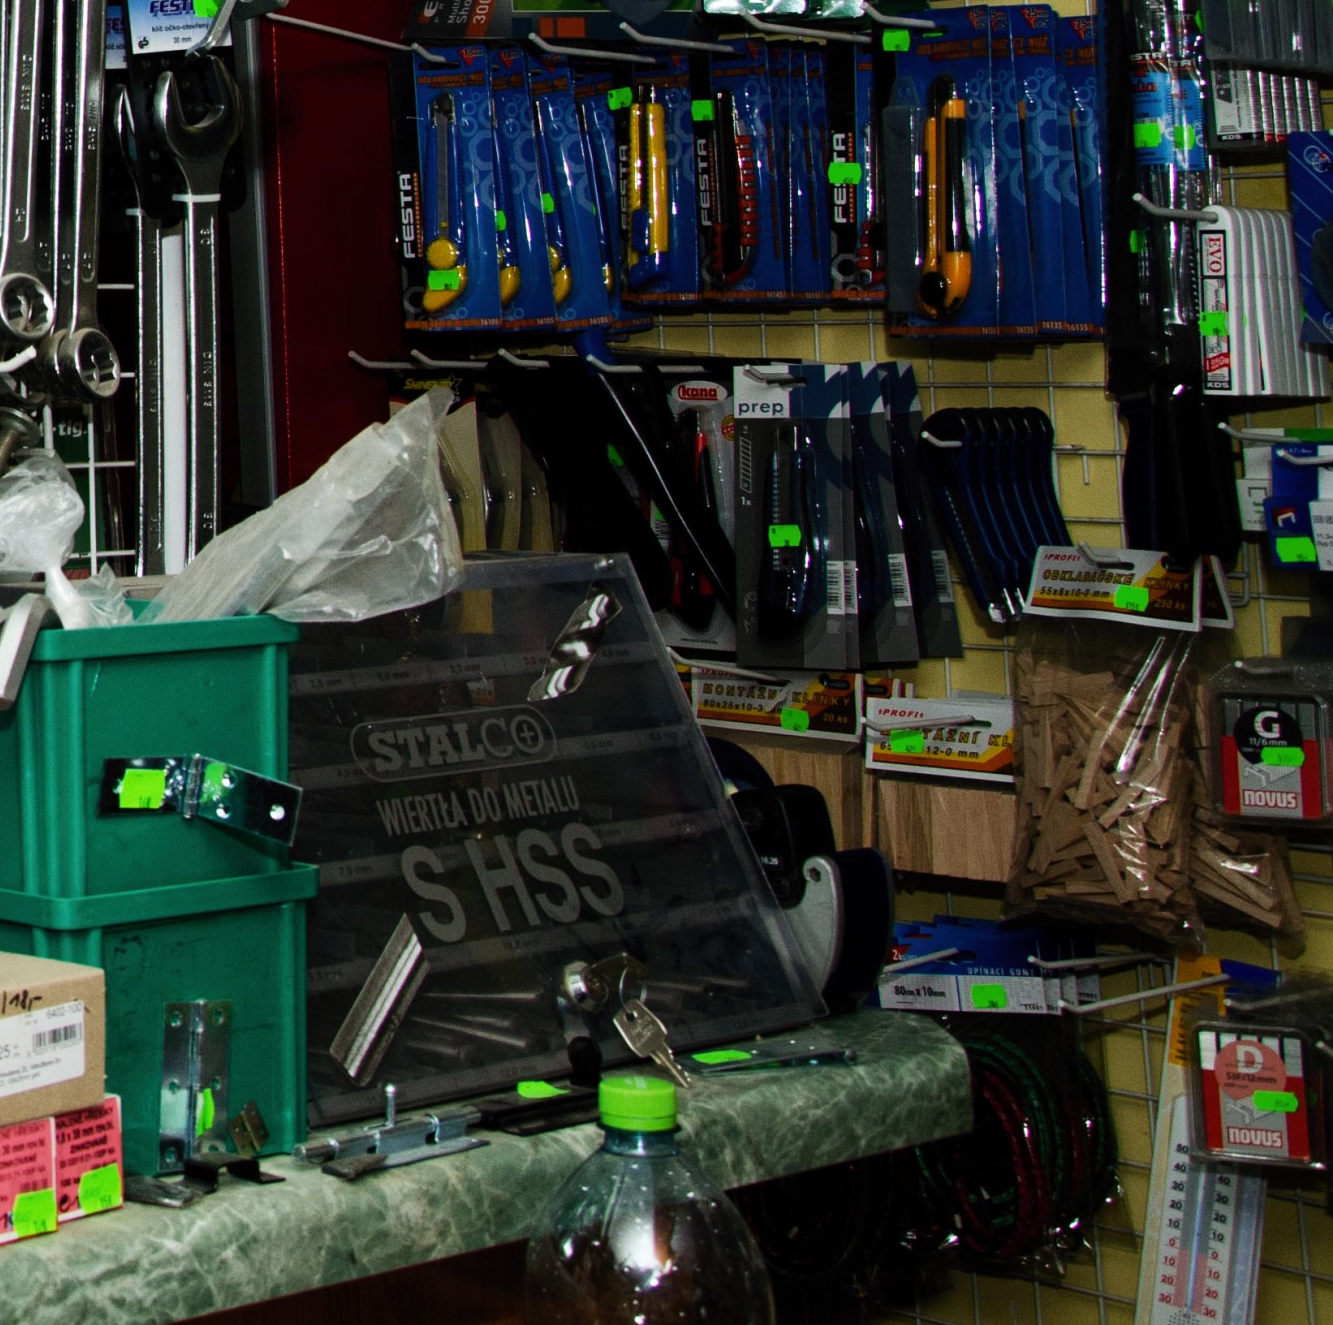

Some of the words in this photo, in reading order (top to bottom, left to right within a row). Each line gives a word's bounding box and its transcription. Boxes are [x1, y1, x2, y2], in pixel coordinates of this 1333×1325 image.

[697, 138, 713, 227] FESTA
[399, 172, 416, 259] FESTA
[1208, 236, 1222, 274] EVO
[738, 401, 784, 416] prep
[741, 496, 752, 506] 1x
[1253, 710, 1281, 739] G
[367, 714, 545, 773] STALCO
[375, 791, 469, 837] WIERTŁA
[467, 786, 503, 825] DO
[501, 775, 580, 820] METALU
[400, 844, 467, 943] S
[463, 822, 624, 933] HSS
[1235, 1045, 1264, 1074] D
[1176, 1143, 1189, 1154] 50
[1173, 1162, 1186, 1173] 40
[1171, 1181, 1184, 1191] 30
[1169, 1199, 1182, 1209] 20
[1167, 1218, 1181, 1228] 10
[1168, 1237, 1176, 1247] 0
[1163, 1255, 1176, 1266] 10
[1161, 1274, 1174, 1285] 20
[1158, 1293, 1172, 1303] 30
